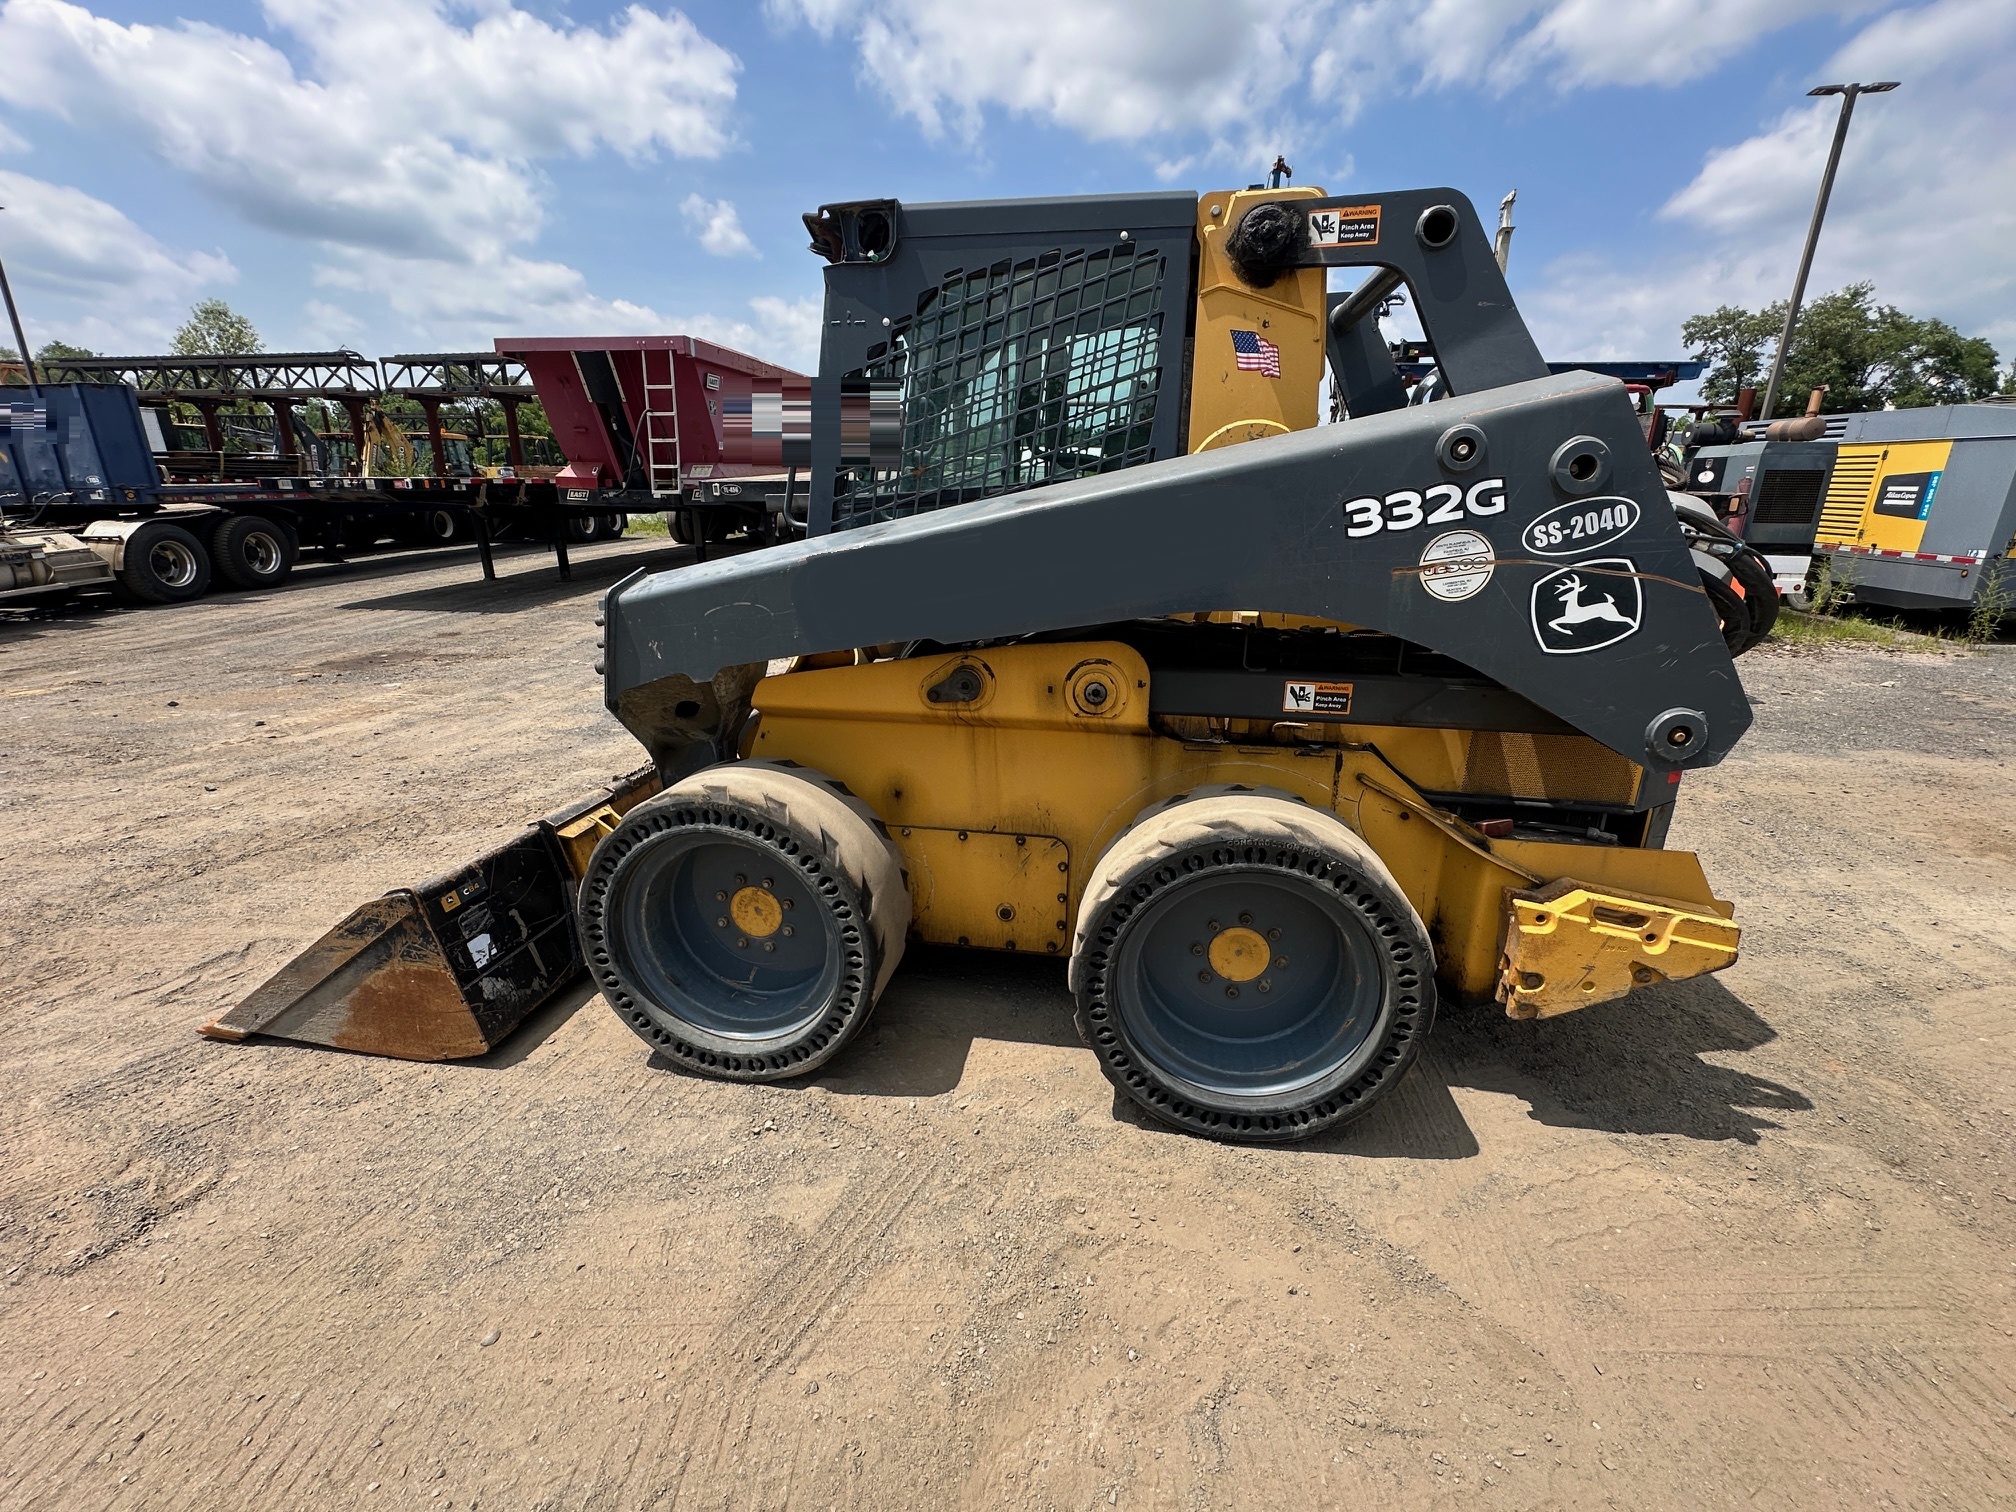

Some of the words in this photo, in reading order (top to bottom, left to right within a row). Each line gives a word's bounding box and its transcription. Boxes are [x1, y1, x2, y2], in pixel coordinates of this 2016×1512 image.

[1341, 223, 1359, 231] Pinch
[1344, 478, 1506, 538] 332G
[1532, 503, 1629, 549] SS-2040
[1302, 848, 1321, 858] PRO
